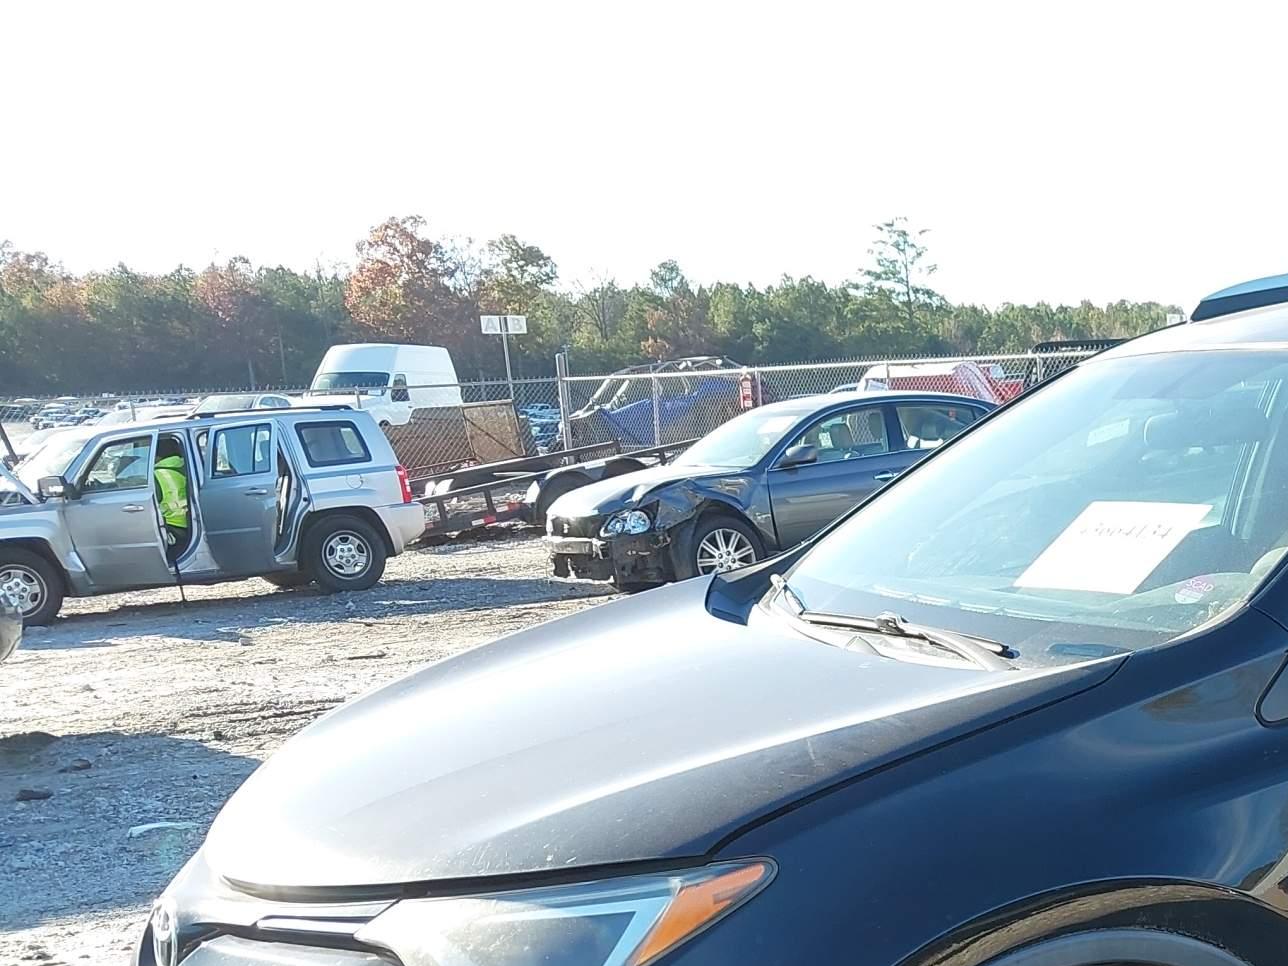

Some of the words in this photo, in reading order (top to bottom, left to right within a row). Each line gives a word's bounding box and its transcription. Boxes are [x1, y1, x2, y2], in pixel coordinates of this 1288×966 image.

[484, 318, 498, 332] A
[512, 318, 523, 332] B
[1185, 579, 1214, 593] SCAD
